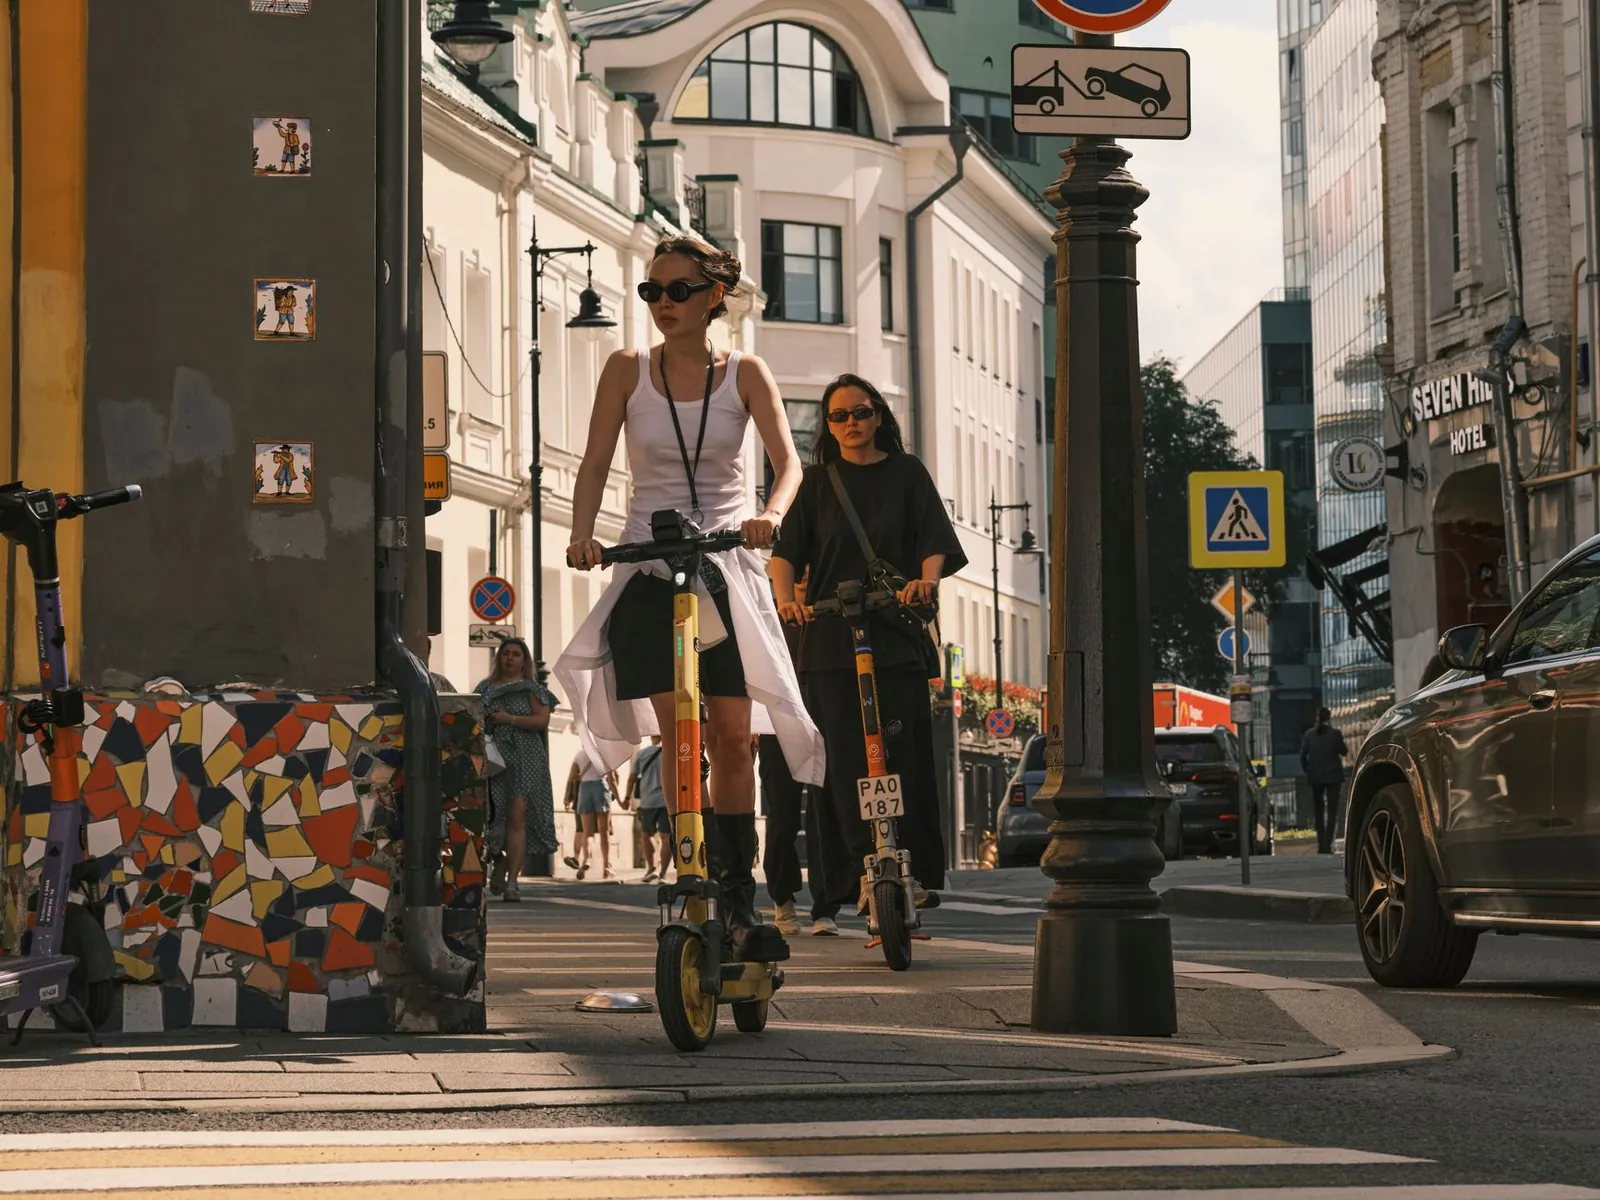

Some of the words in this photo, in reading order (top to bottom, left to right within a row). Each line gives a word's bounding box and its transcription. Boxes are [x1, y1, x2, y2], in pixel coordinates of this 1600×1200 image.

[1412, 374, 1463, 422] SEVEN
[1450, 423, 1487, 455] HOTEL
[864, 798, 899, 817] 187
